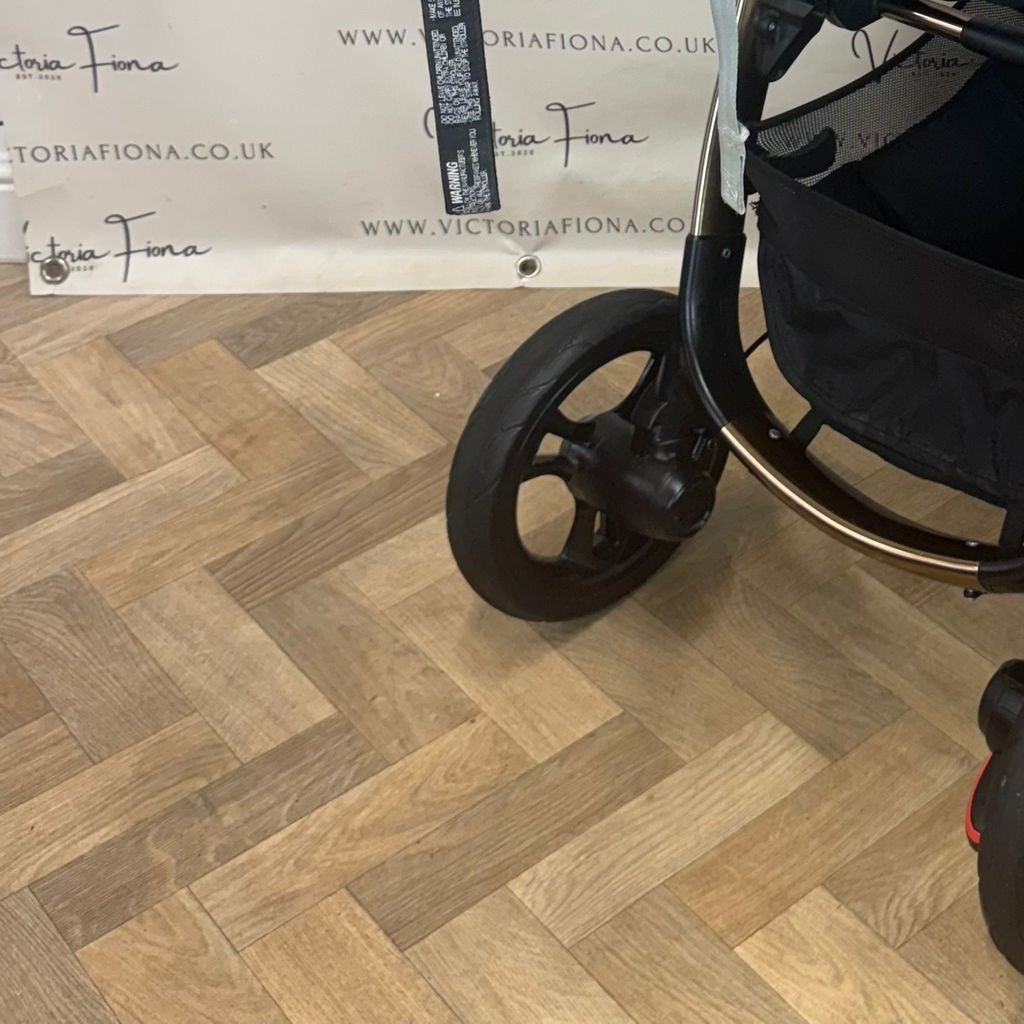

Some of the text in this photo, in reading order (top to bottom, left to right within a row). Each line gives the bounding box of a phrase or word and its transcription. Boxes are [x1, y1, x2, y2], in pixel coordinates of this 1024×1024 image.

[67, 25, 179, 93] Fiona
[8, 143, 275, 163] TORIAFIONA.CO.UK
[546, 102, 649, 167] Fiona
[446, 161, 463, 204] WARNING
[104, 211, 212, 282] Fiona
[361, 217, 685, 237] WWW.VICTORIAFIONA.CO
